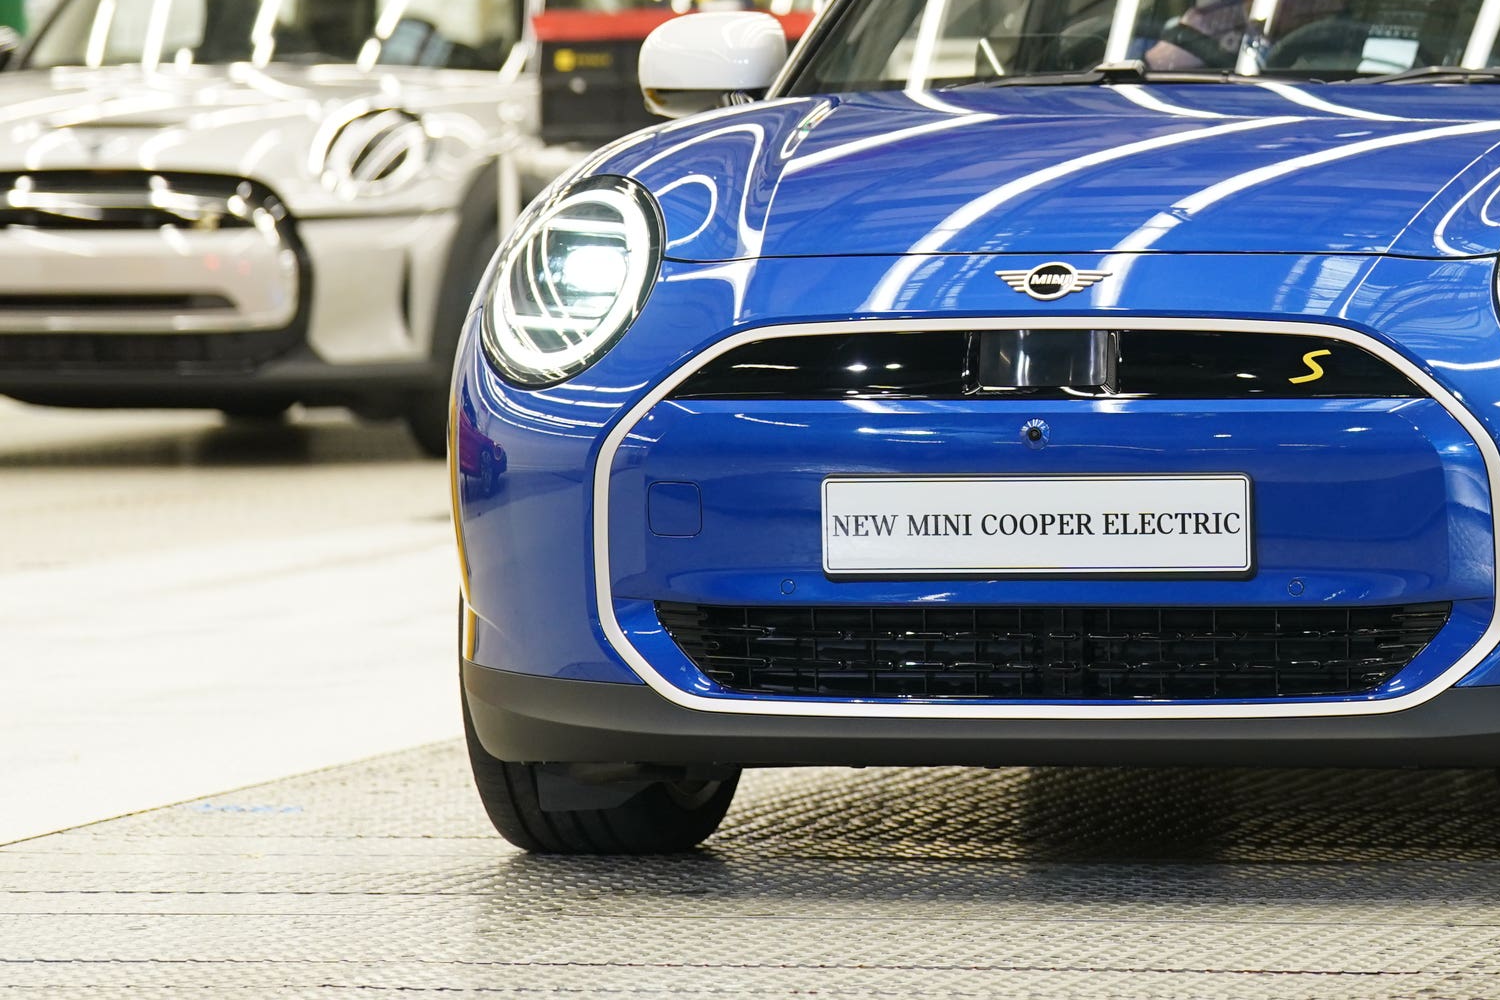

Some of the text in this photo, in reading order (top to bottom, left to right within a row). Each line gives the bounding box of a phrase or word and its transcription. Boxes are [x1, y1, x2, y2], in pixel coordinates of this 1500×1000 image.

[1030, 273, 1074, 285] MINI
[1288, 349, 1332, 384] S
[832, 512, 1240, 536] NEW MINI COOPER ELECTRIC
